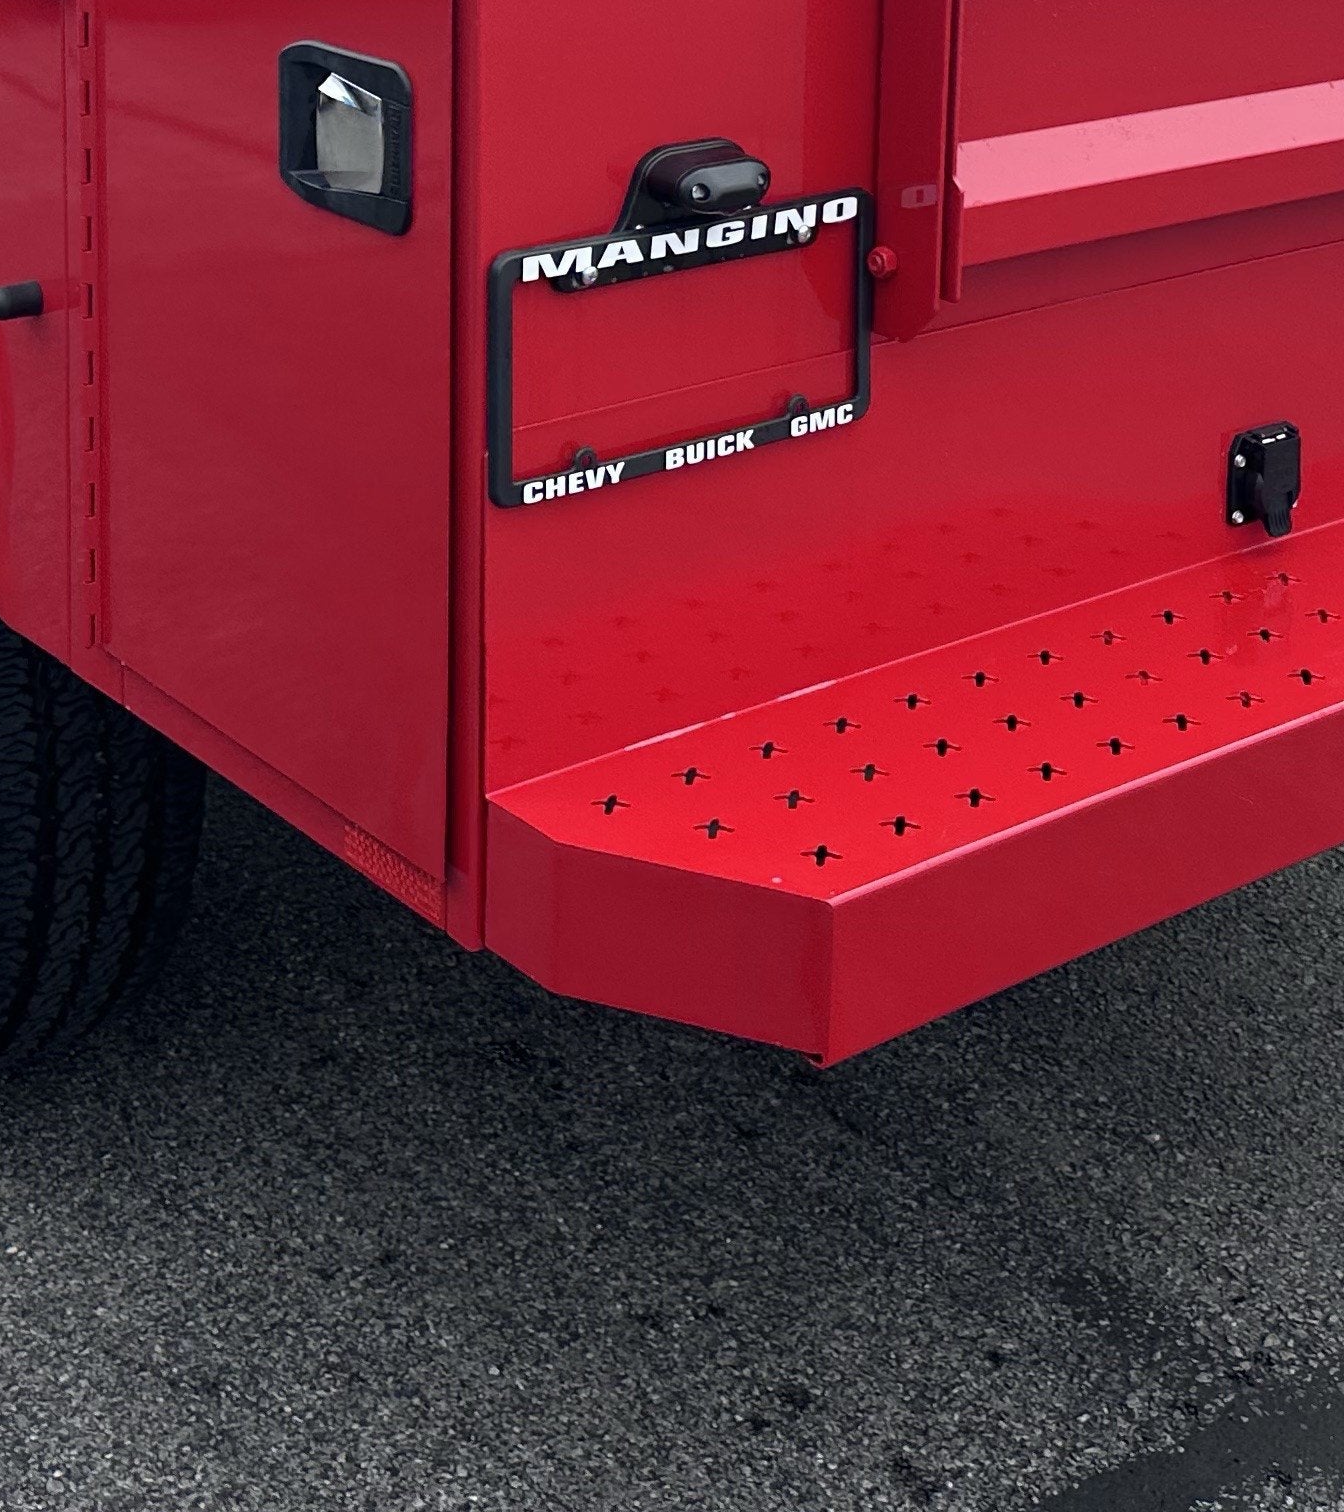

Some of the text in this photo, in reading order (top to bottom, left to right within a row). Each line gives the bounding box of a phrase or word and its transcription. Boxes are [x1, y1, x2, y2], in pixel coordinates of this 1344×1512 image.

[522, 196, 858, 283] MANGINO
[522, 403, 854, 505] CHEVY BUICK GMC
